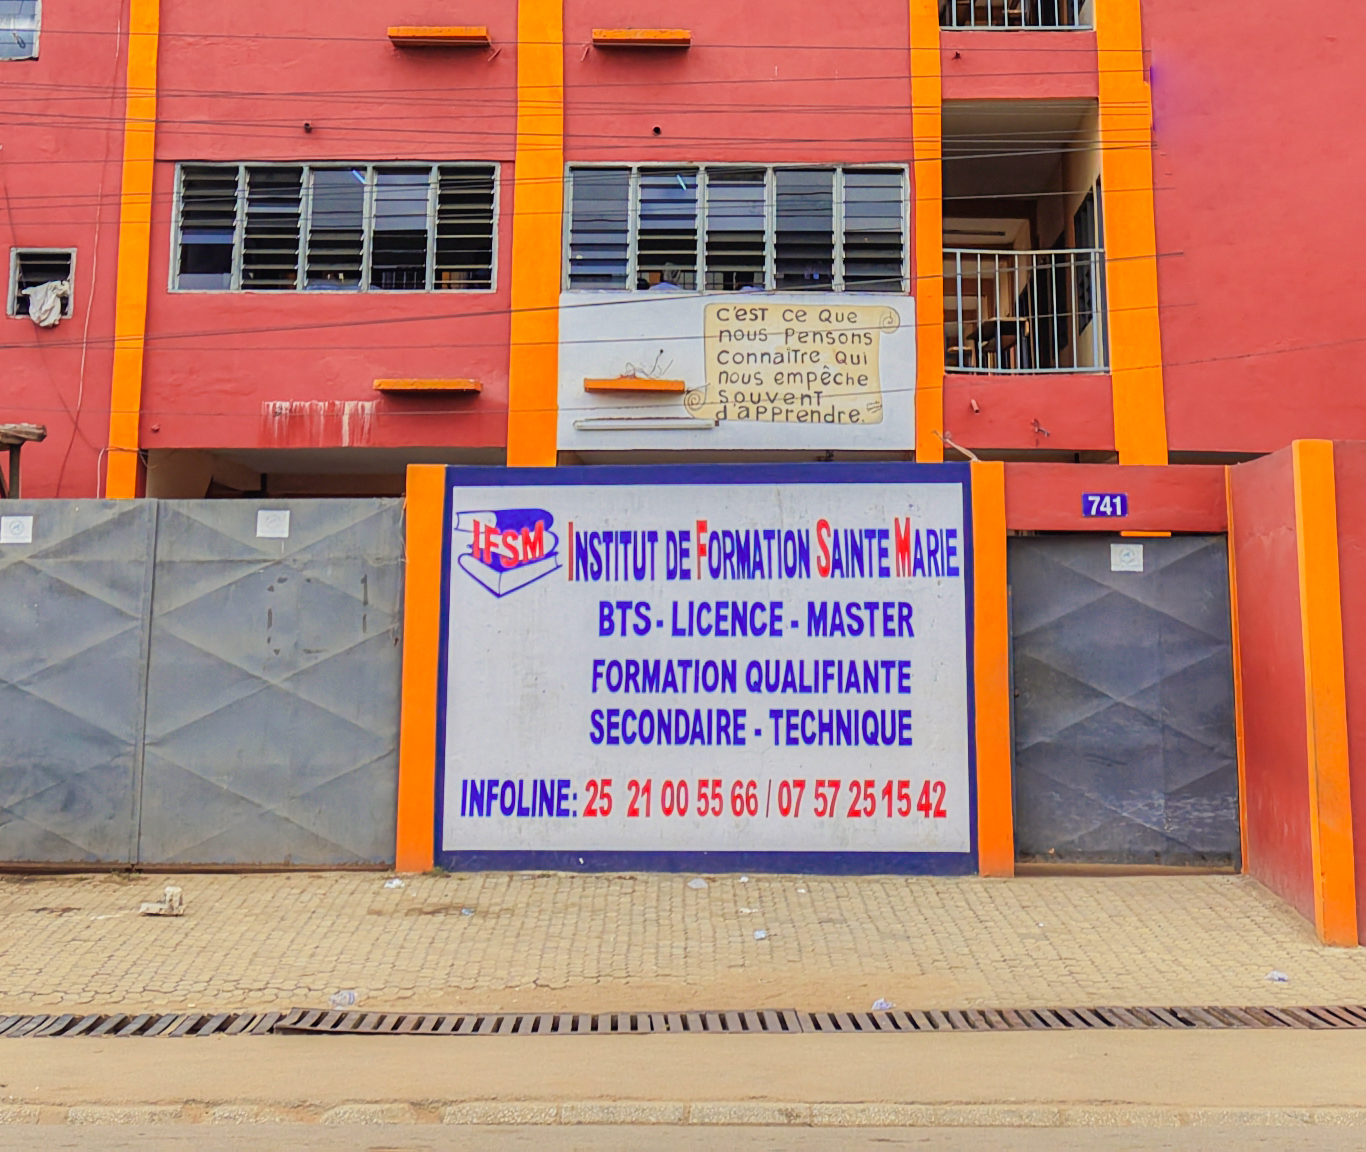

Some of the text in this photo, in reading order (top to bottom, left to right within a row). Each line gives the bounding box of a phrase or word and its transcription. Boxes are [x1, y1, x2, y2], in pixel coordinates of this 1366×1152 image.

[718, 328, 768, 343] nous
[718, 365, 869, 391] nous empêche
[1088, 495, 1122, 516] 741
[472, 518, 545, 567] IFSM
[567, 516, 960, 582] INSTITUT DE FORMATION SAINTE MARIE
[598, 601, 651, 637] BTS
[671, 601, 784, 637] LICENCE
[807, 602, 915, 638] MASTER
[591, 659, 912, 695] FORMATION QUALIFIANTE
[589, 708, 747, 746] SECONDAIRE
[769, 709, 913, 747] TECHNIQUE
[460, 779, 578, 818] INFOLINE:
[582, 779, 613, 818] 25
[626, 779, 651, 818] 21
[660, 779, 690, 818] 00
[696, 779, 724, 818] 55
[731, 779, 759, 818] 66
[777, 779, 806, 818] 07
[813, 779, 841, 818] 57
[847, 779, 877, 818] 25
[881, 779, 912, 818] 15
[916, 779, 948, 818] 42
